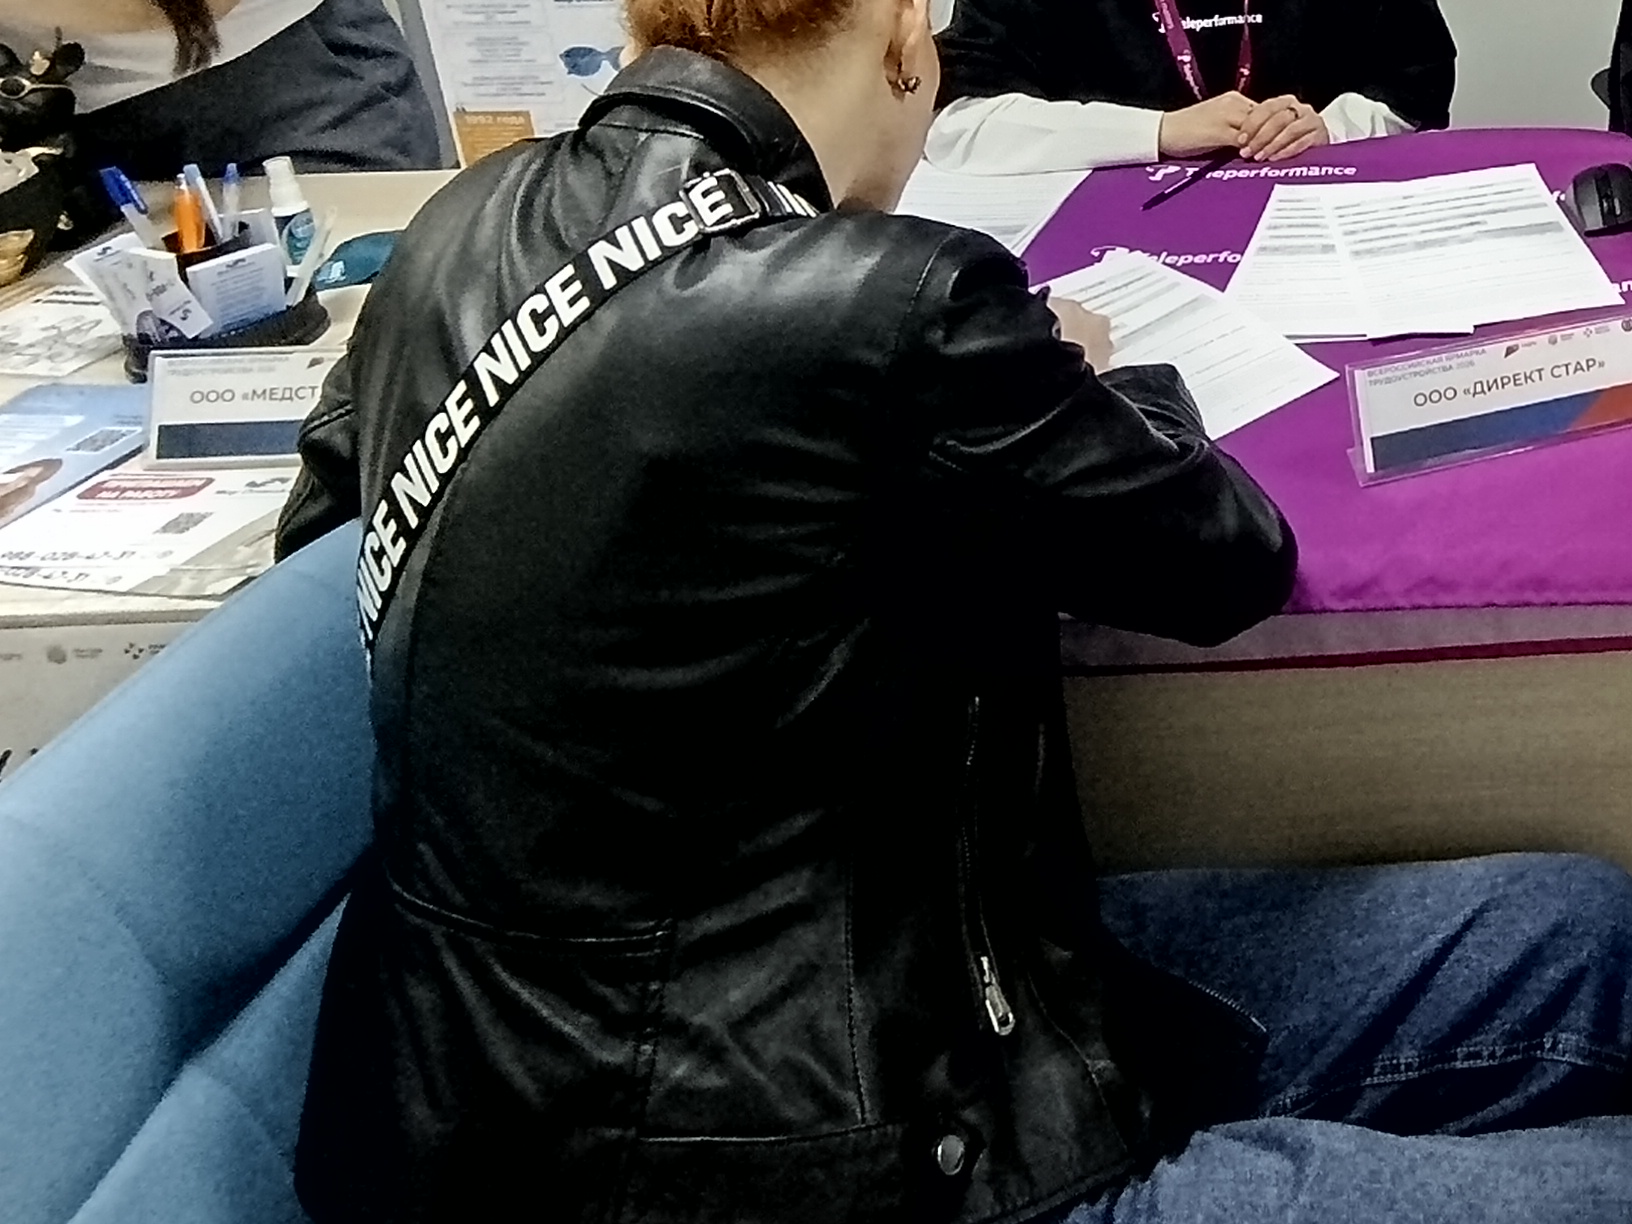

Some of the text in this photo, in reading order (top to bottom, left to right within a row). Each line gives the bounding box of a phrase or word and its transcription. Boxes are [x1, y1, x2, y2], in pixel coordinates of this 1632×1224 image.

[1185, 166, 1357, 180] Teperformance
[190, 385, 320, 404] ООО «МЕДСТ
[1414, 357, 1605, 407] ООО «ДИРЕКТ СТАР»
[356, 500, 407, 640] NICE
[389, 379, 480, 529] NICE
[473, 264, 591, 407] NICE
[587, 176, 734, 291] NICE
